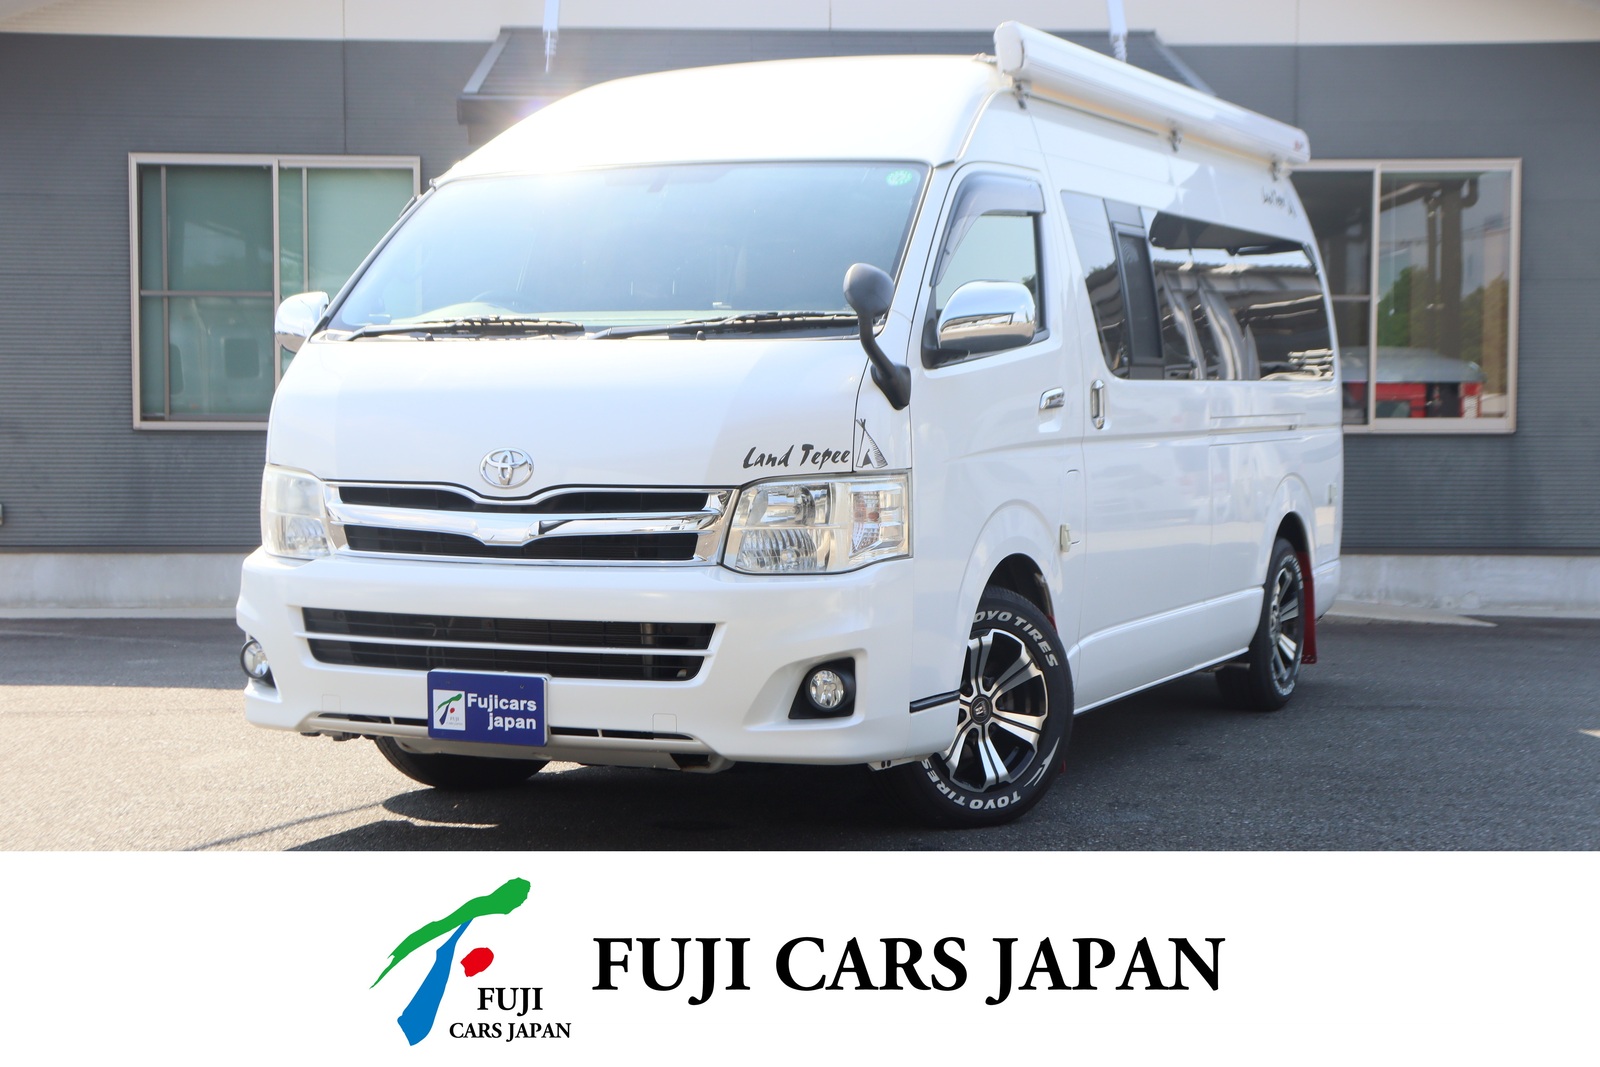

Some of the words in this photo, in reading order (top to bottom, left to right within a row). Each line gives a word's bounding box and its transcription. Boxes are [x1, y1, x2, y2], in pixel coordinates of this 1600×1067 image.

[742, 444, 795, 469] Land
[799, 443, 851, 471] Tepee
[973, 610, 1013, 623] OYO
[1014, 615, 1059, 667] TIRES
[467, 692, 537, 712] Fujicars
[487, 712, 537, 731] japan
[921, 758, 966, 807] TIRES
[968, 790, 1022, 810] TOYO
